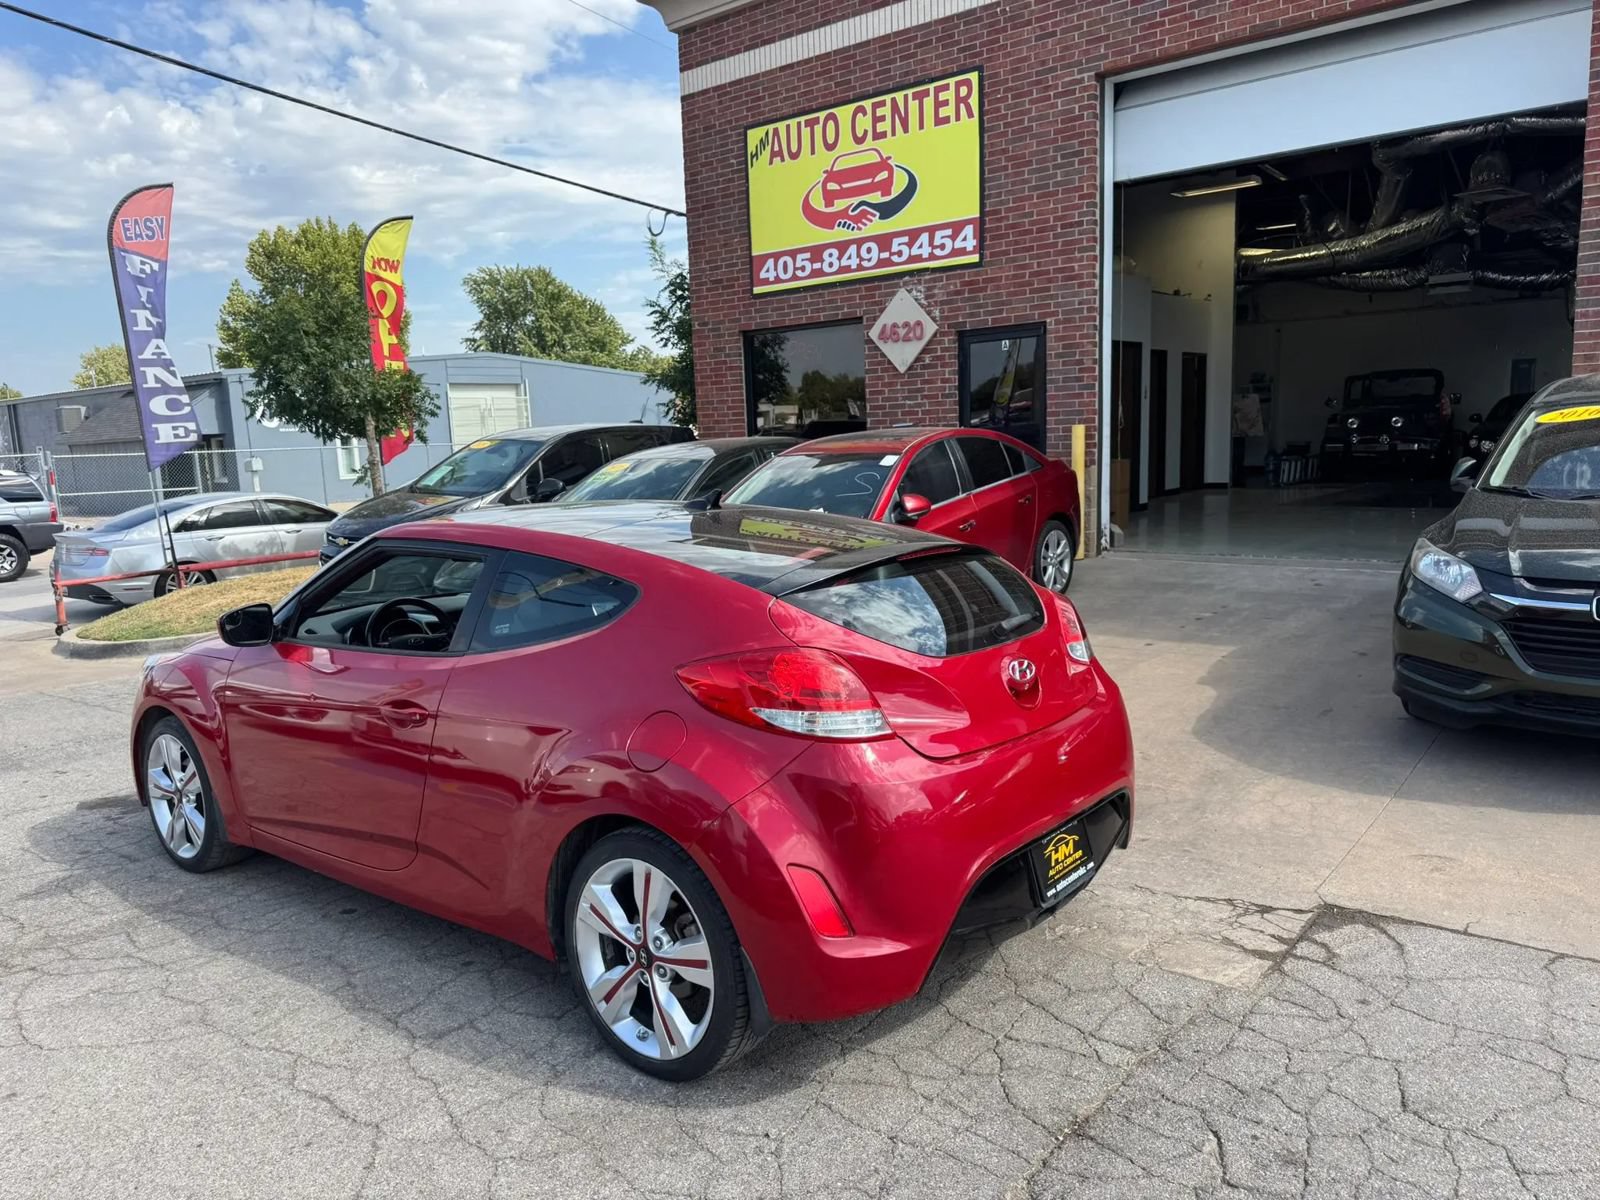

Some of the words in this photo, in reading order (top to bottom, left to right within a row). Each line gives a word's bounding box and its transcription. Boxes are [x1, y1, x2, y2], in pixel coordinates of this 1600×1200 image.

[749, 129, 770, 168] HM
[768, 111, 840, 166] AUTO
[851, 77, 975, 146] CENTER
[119, 215, 166, 243] EASY
[759, 224, 977, 282] 405-849-5454
[878, 319, 925, 344] 4620
[1051, 839, 1074, 867] HM
[1048, 862, 1064, 877] AUTO
